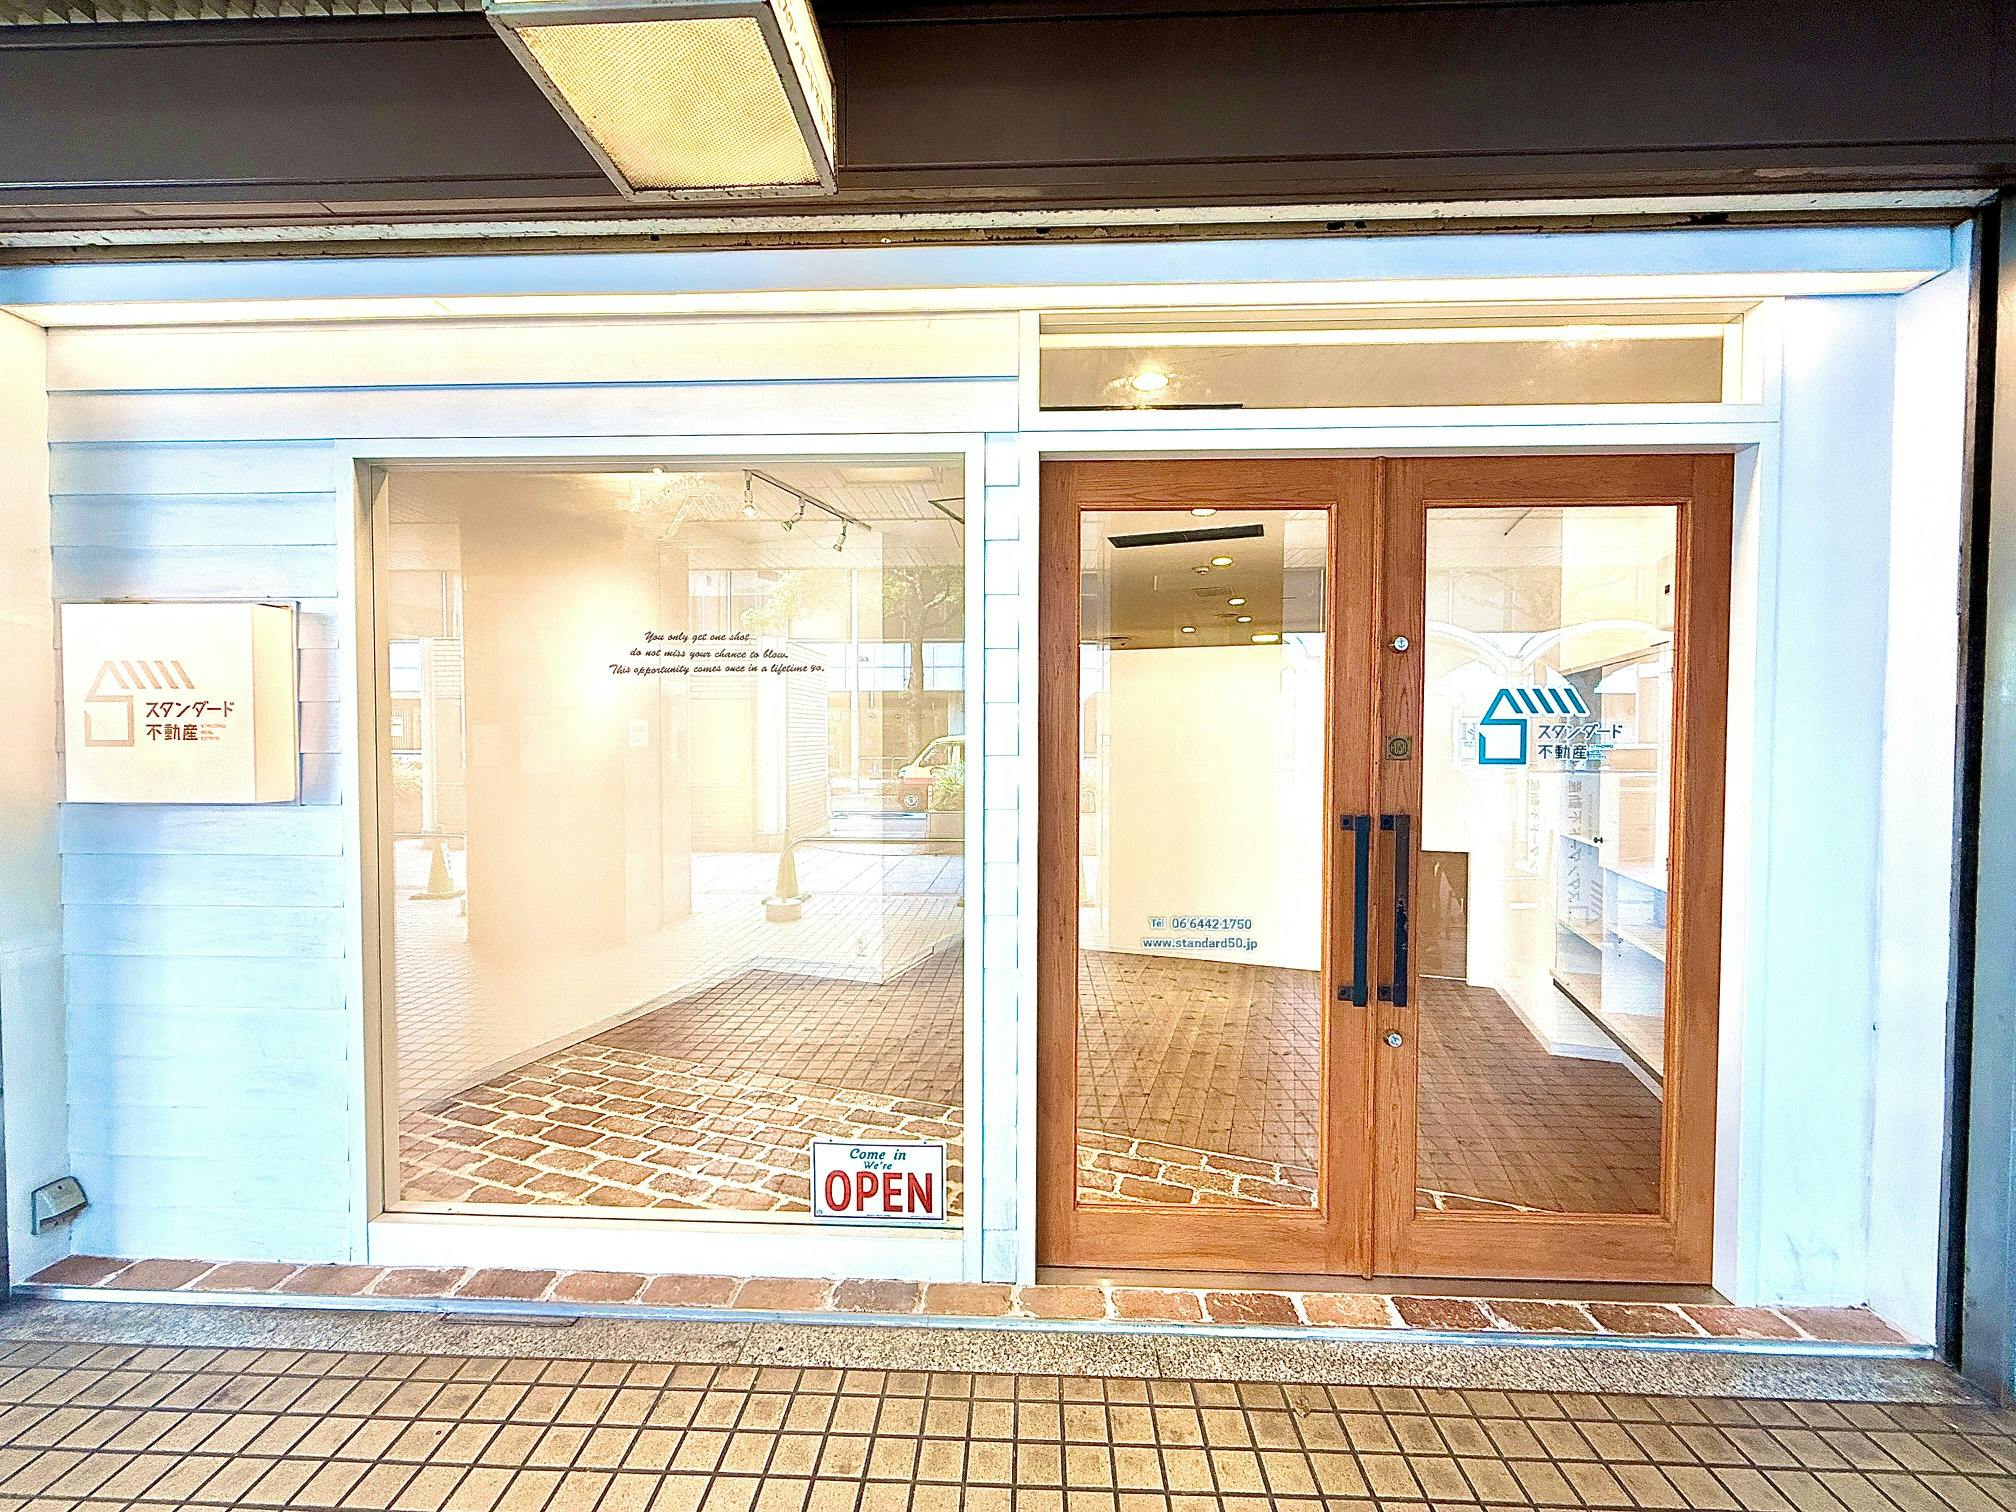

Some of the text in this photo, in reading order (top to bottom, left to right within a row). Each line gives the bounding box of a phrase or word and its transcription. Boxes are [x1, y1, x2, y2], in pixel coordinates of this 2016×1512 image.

[644, 631, 665, 643] You
[667, 631, 690, 643] only
[692, 633, 708, 643] get
[728, 631, 751, 641] shot
[629, 647, 789, 660] do not miss your chance to blow.
[609, 664, 631, 675] This
[633, 664, 690, 677] opportunity
[693, 664, 722, 673] comes
[725, 665, 746, 673] once
[748, 663, 758, 672] in
[770, 663, 809, 676] lifetime
[145, 700, 235, 718] スタンダード
[145, 723, 199, 741] 不動産
[1537, 723, 1623, 740] スタンダード
[1537, 744, 1587, 760] 不動産
[1143, 937, 1258, 950] www.standard50.jp
[849, 1148, 907, 1161] Come in
[863, 1161, 893, 1170] We're
[824, 1169, 933, 1213] OPEN
